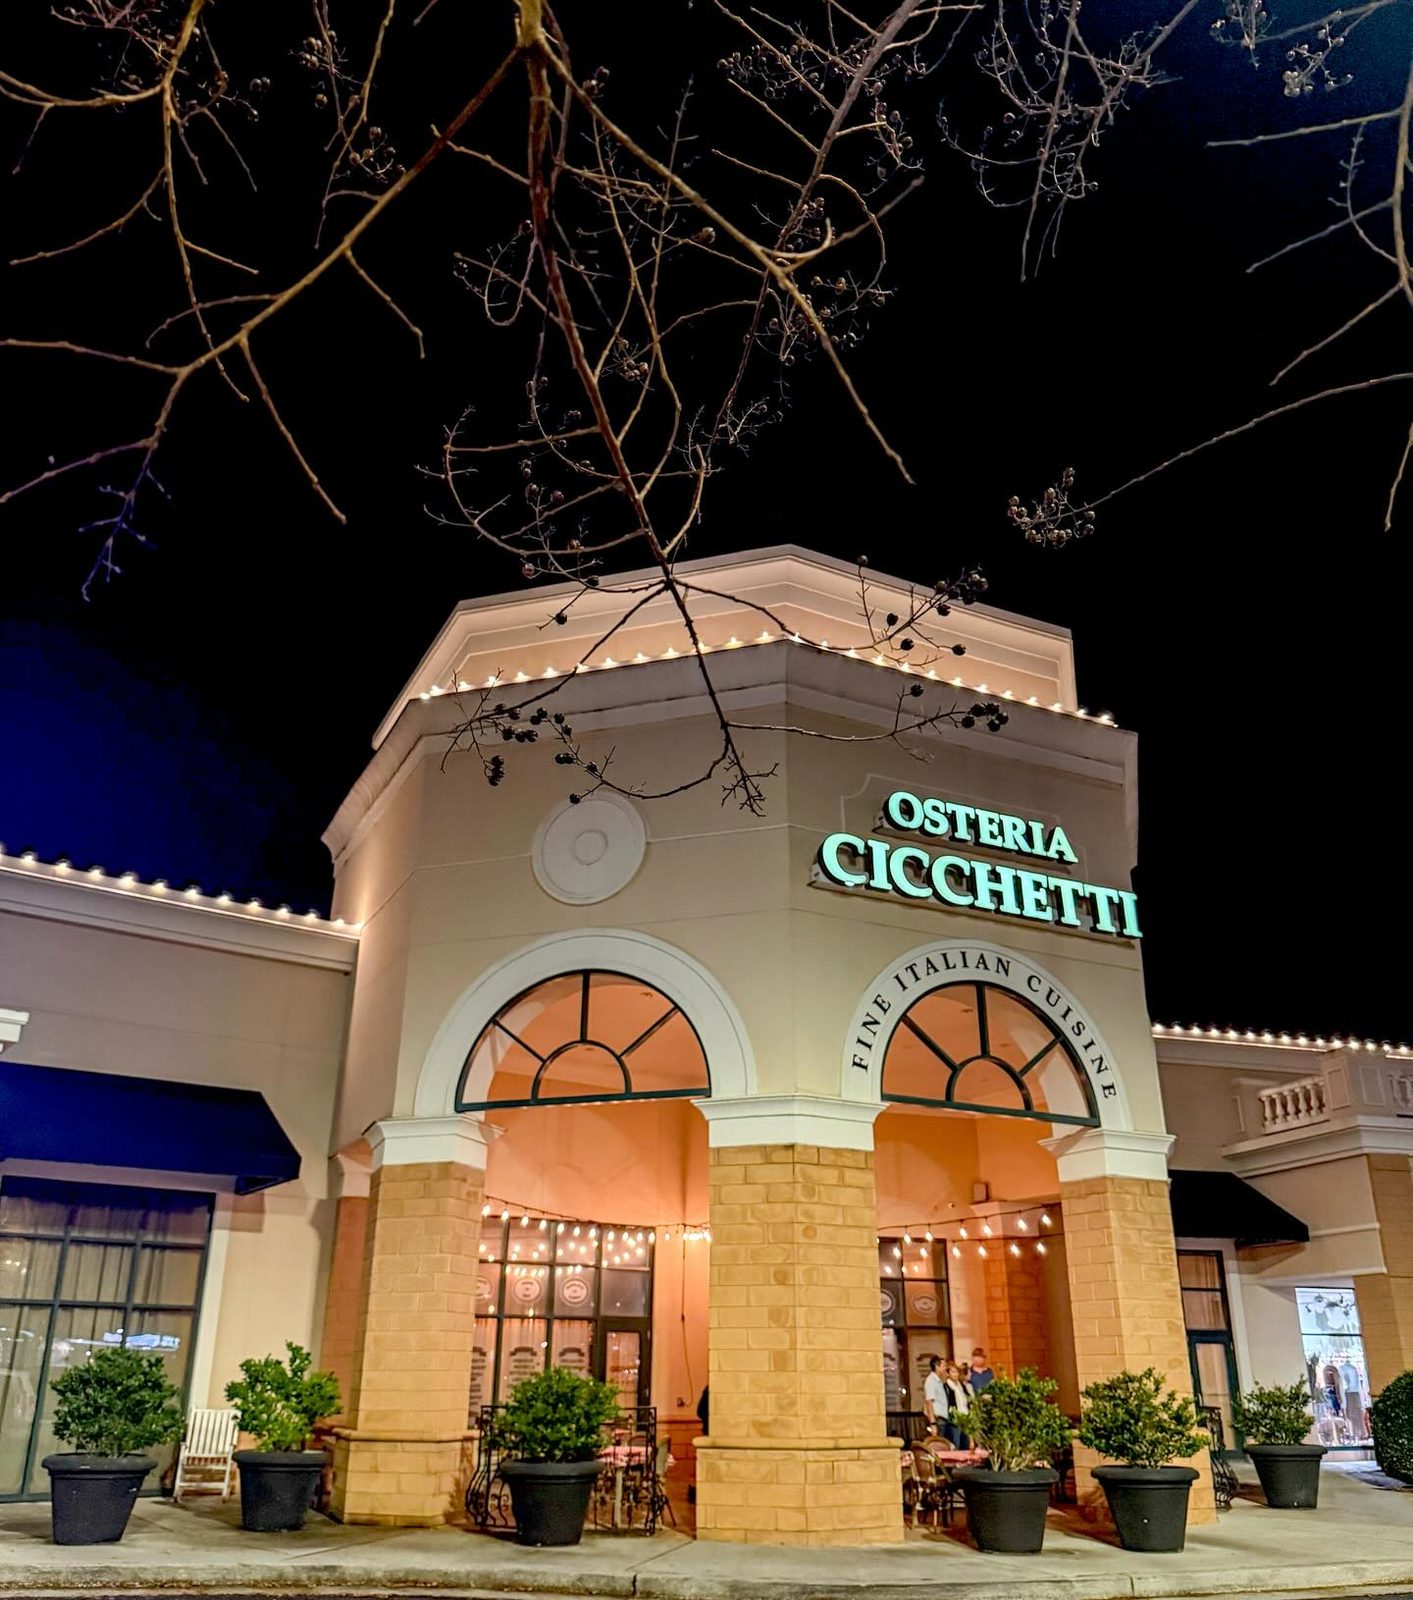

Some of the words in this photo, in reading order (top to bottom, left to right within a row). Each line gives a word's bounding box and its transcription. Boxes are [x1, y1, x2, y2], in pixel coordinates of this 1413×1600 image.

[887, 790, 1078, 863] OSTERIA
[821, 832, 1144, 938] CICCHETTI
[852, 994, 892, 1072] FINE
[894, 951, 1011, 992] ITALIAN
[1027, 975, 1117, 1099] CUISINE
